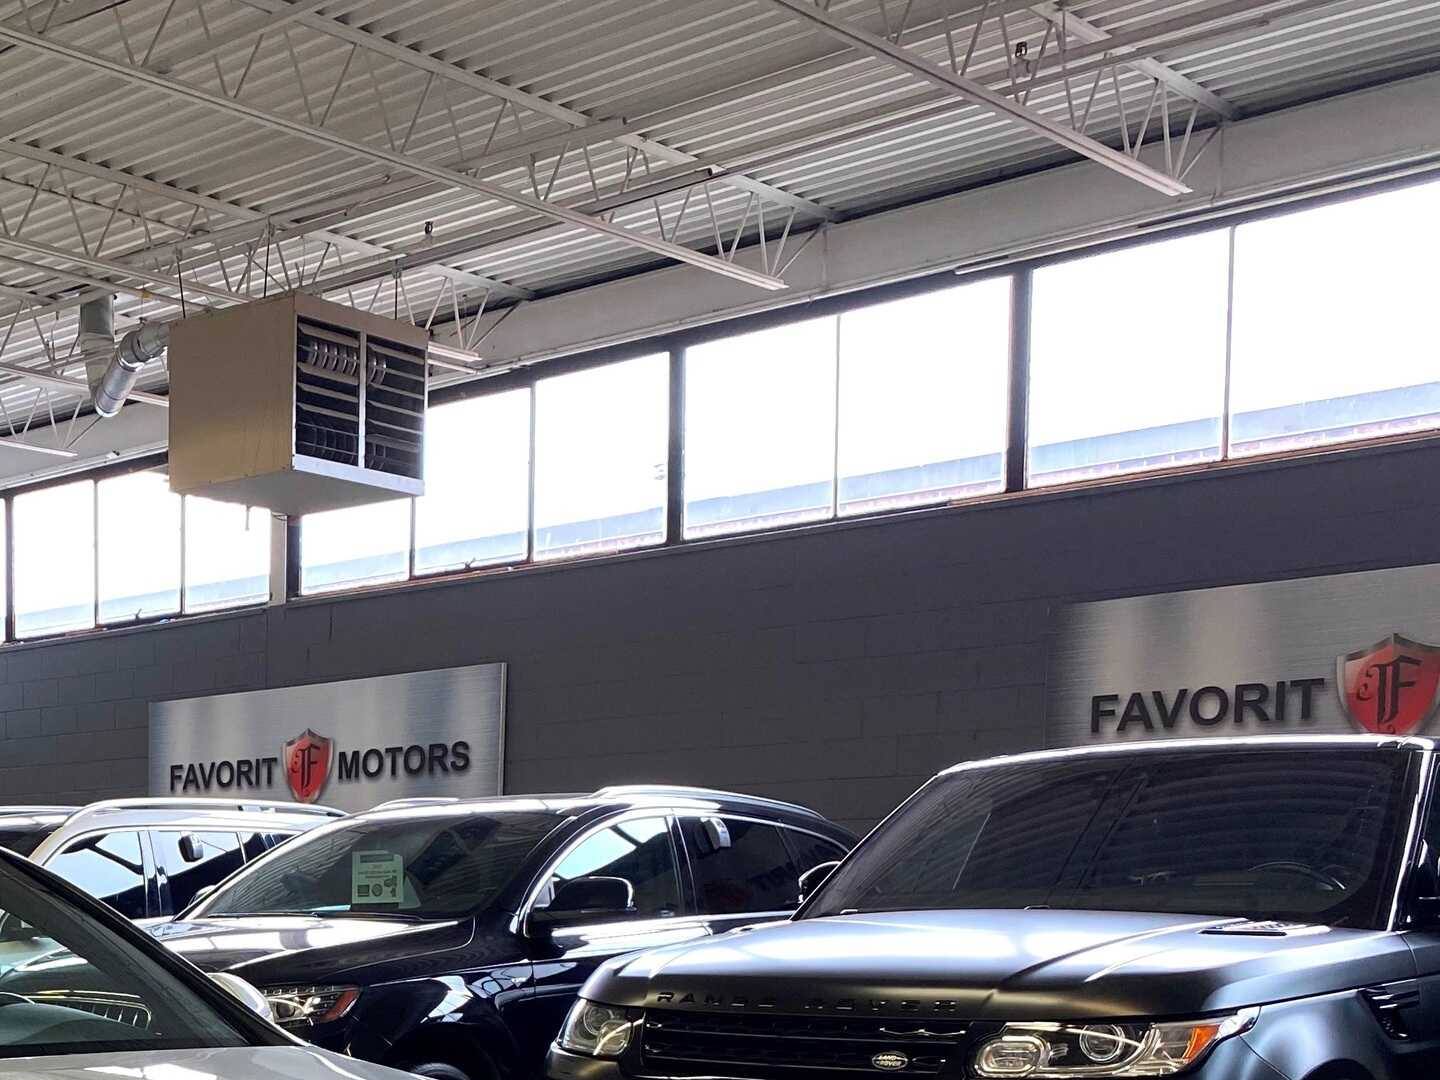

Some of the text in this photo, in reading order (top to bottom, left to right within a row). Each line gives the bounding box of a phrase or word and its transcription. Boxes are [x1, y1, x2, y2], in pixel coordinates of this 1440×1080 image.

[1091, 678, 1325, 733] FAVORIT
[170, 757, 277, 792] FAVORIT
[338, 741, 470, 781] MOTORS
